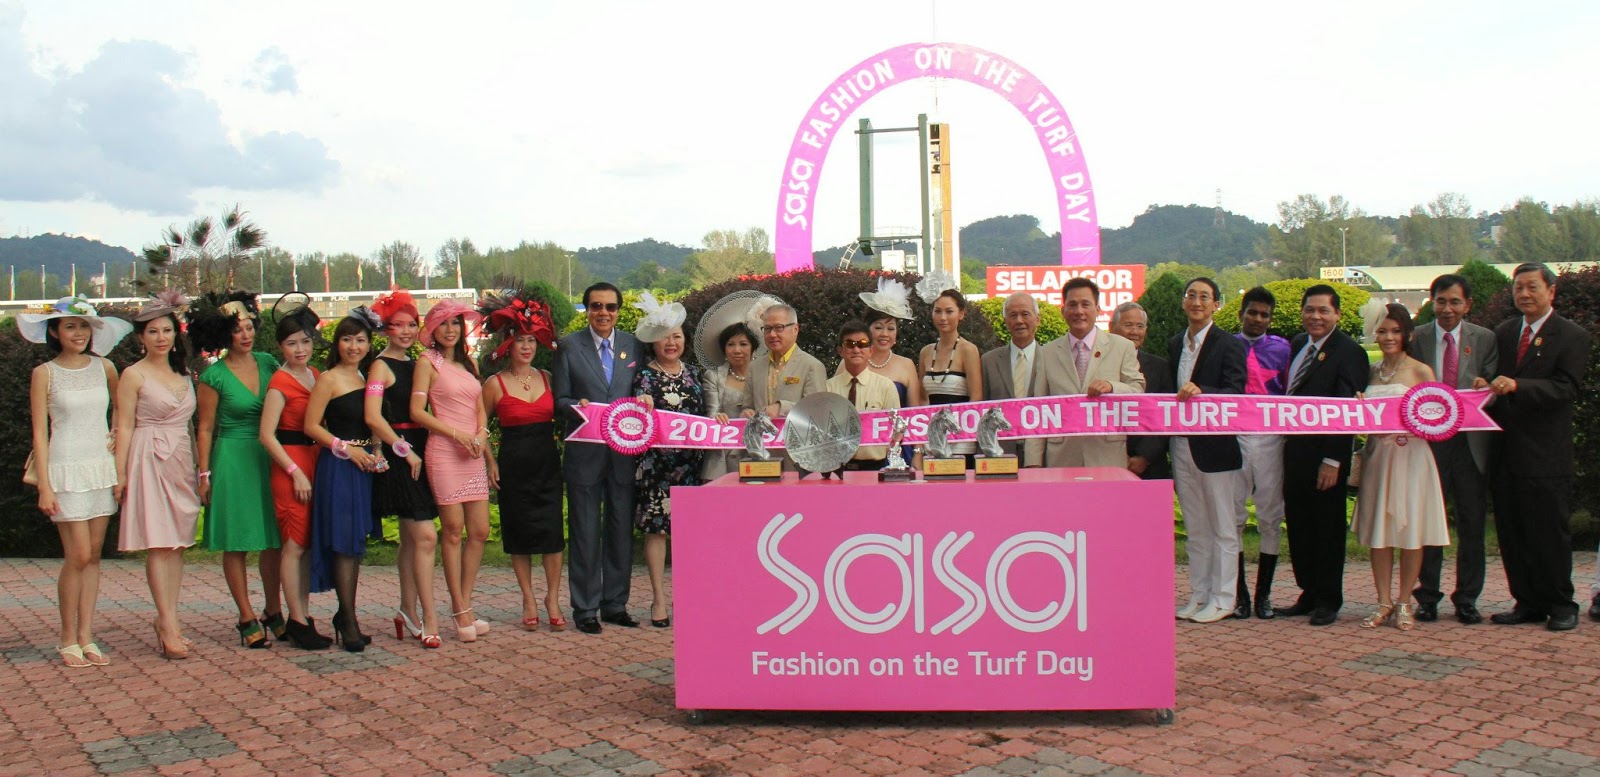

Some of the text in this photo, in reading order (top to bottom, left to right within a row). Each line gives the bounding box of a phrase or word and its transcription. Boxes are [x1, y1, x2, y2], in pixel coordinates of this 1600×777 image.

[801, 58, 895, 149] FASHION
[915, 47, 952, 70] ON
[973, 53, 1024, 93] THE
[1028, 92, 1075, 157] TURF
[1061, 172, 1090, 222] DAY
[1099, 292, 1133, 311] UP
[669, 419, 740, 443] 2012
[1020, 404, 1062, 430] ON
[1080, 402, 1139, 427] THE
[1158, 402, 1238, 427] TURF
[1257, 402, 1386, 427] TROPHY
[752, 650, 1093, 681] Fashion on the Turf Day
